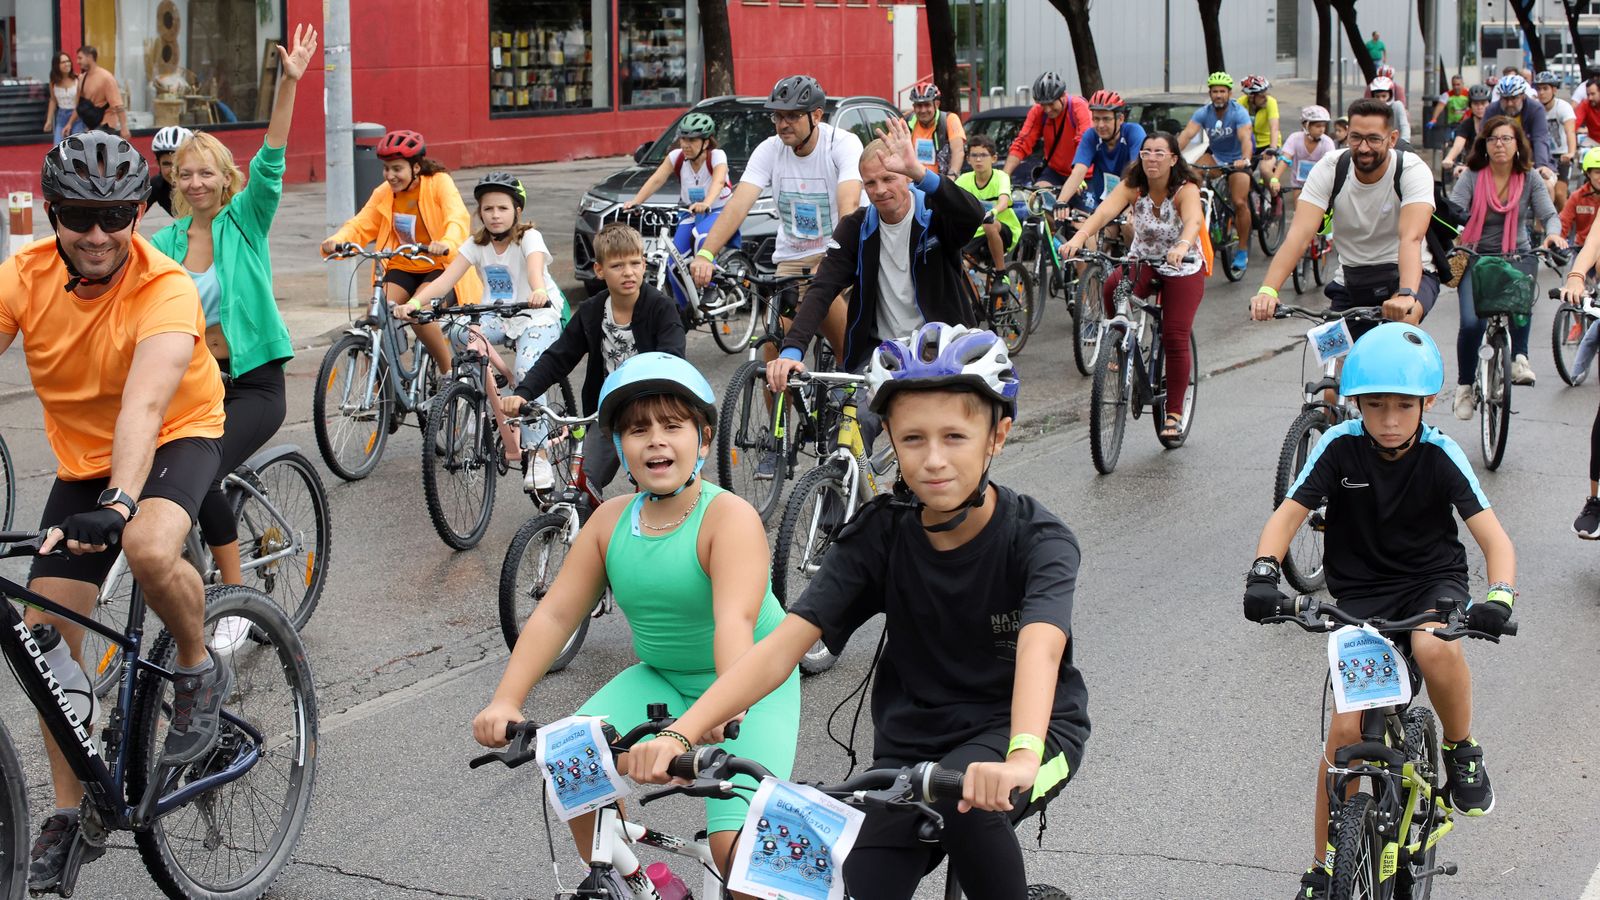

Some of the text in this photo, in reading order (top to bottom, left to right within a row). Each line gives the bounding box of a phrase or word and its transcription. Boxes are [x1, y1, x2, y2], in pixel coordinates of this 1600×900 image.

[1343, 641, 1356, 649] BICI
[12, 621, 98, 758] ROCKRIDER
[562, 729, 586, 745] AMISTAD
